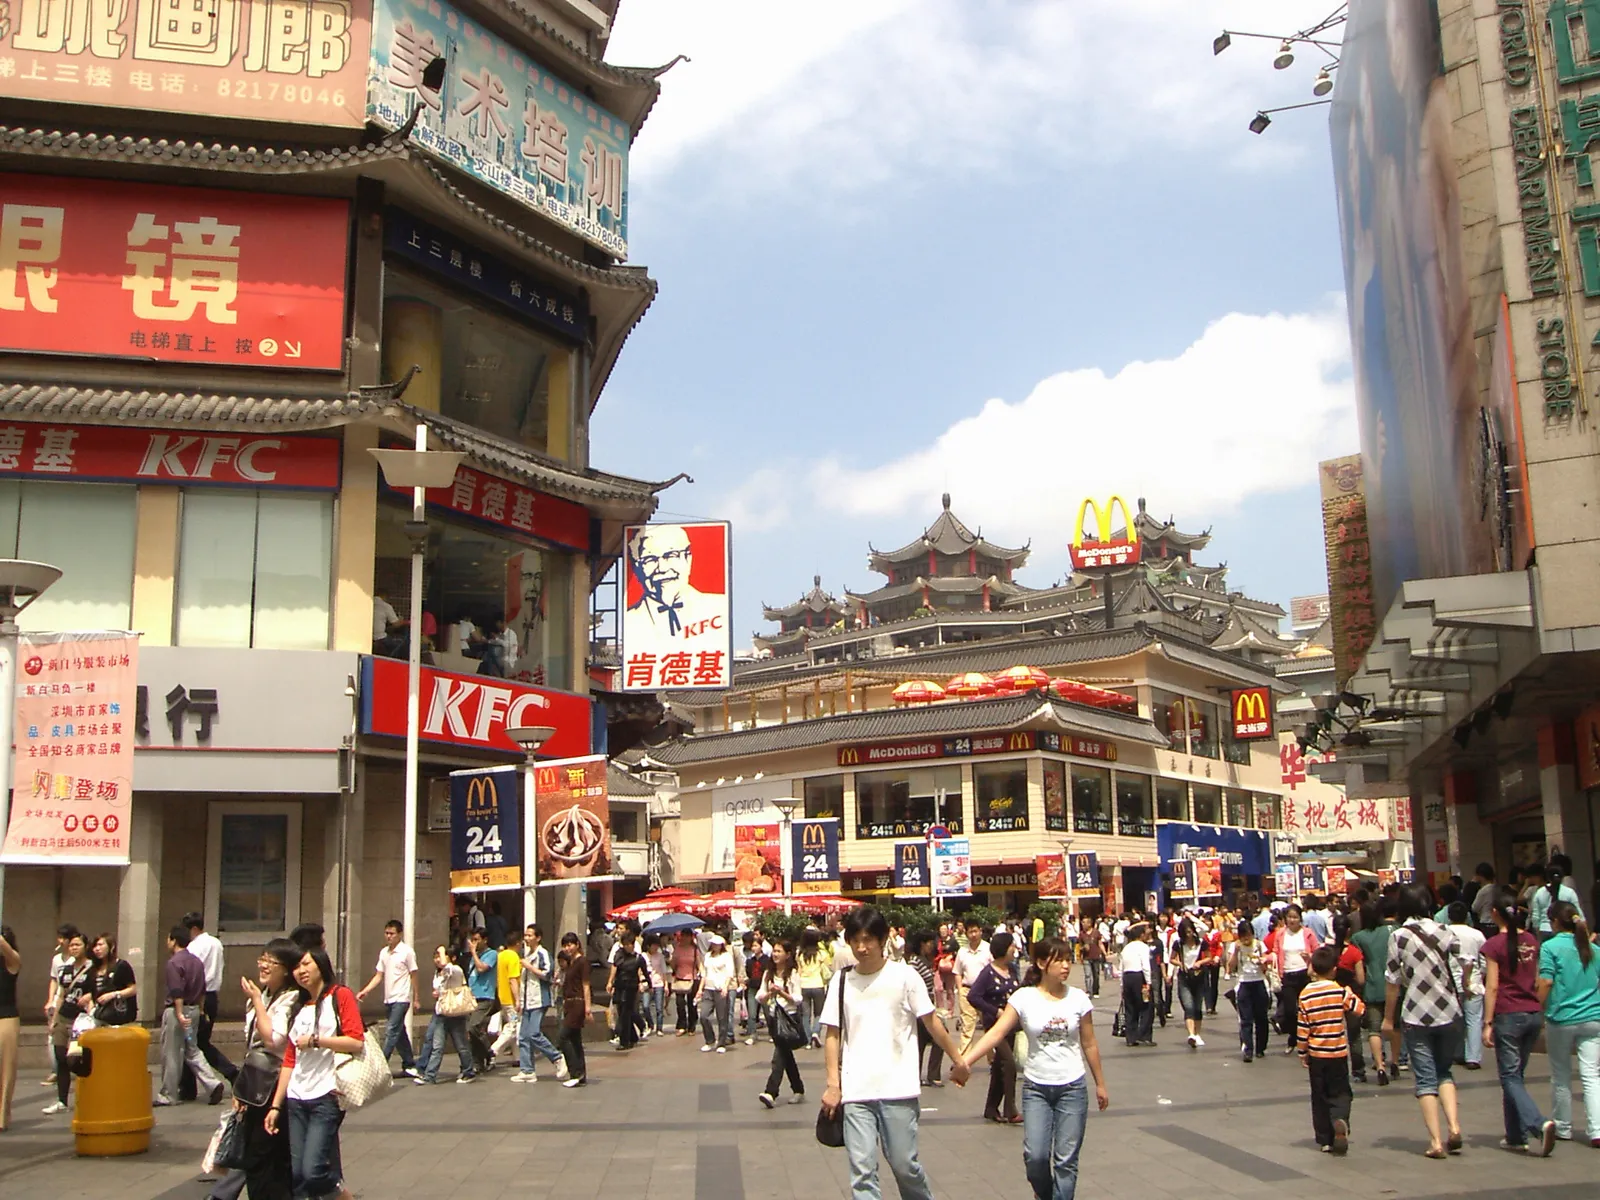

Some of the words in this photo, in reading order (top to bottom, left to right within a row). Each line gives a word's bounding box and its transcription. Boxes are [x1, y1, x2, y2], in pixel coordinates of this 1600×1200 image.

[1497, 0, 1533, 86] ORLD
[217, 78, 346, 107] 82178046
[1509, 105, 1563, 295] DEPARTMENT
[580, 216, 624, 252] 82178046
[130, 330, 217, 353] 电梯直上
[1536, 316, 1574, 418] STORE
[137, 434, 281, 481] KFC
[452, 471, 535, 531] 肯德基
[1077, 546, 1133, 558] McDonald's
[684, 615, 723, 639] KFC
[627, 650, 726, 687] 肯德基
[137, 683, 219, 741] 行
[423, 676, 545, 741] KFC
[869, 743, 936, 759] McDonald's
[955, 738, 970, 750] 24
[1050, 734, 1059, 745] 24
[871, 825, 884, 836] 24
[989, 818, 1002, 830] 24
[466, 825, 503, 853] 24
[803, 854, 828, 872] 24
[902, 867, 921, 880] 24
[974, 873, 1038, 885] Donald's
[1076, 872, 1092, 883] 24
[1174, 877, 1187, 886] 24
[1303, 878, 1314, 886] 24
